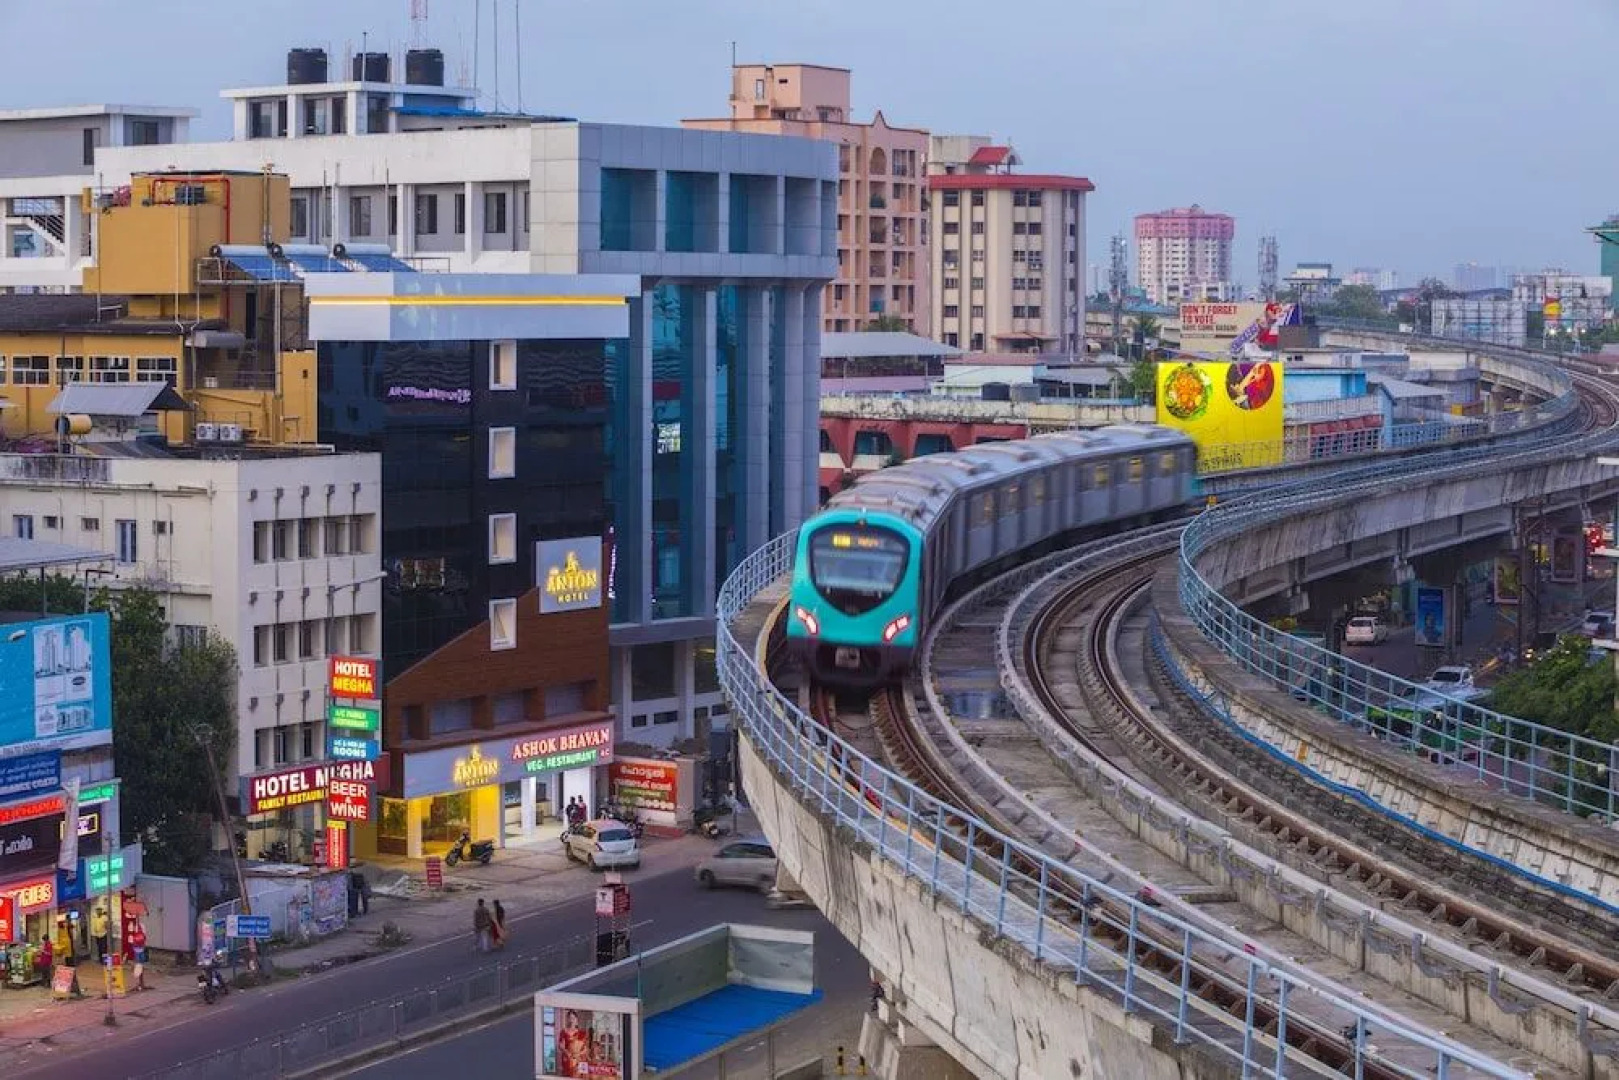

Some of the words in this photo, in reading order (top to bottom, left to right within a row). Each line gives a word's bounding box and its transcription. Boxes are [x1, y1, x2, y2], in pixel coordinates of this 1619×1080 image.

[1208, 305, 1237, 314] FORGET
[1183, 315, 1193, 324] TO
[557, 592, 590, 603] HOTEL
[334, 660, 372, 678] HOTEL
[332, 677, 374, 694] MEGHA
[332, 746, 367, 758] ROOMS
[513, 737, 558, 760] ASHOK
[559, 728, 610, 751] BHAVAN
[547, 749, 597, 768] RESTAURANT
[255, 772, 310, 799] HOTEL
[330, 780, 367, 798] BEER
[257, 796, 286, 811] FAMILY
[287, 788, 329, 806] RESTAURA
[344, 796, 352, 804] &
[330, 802, 367, 819] WINE
